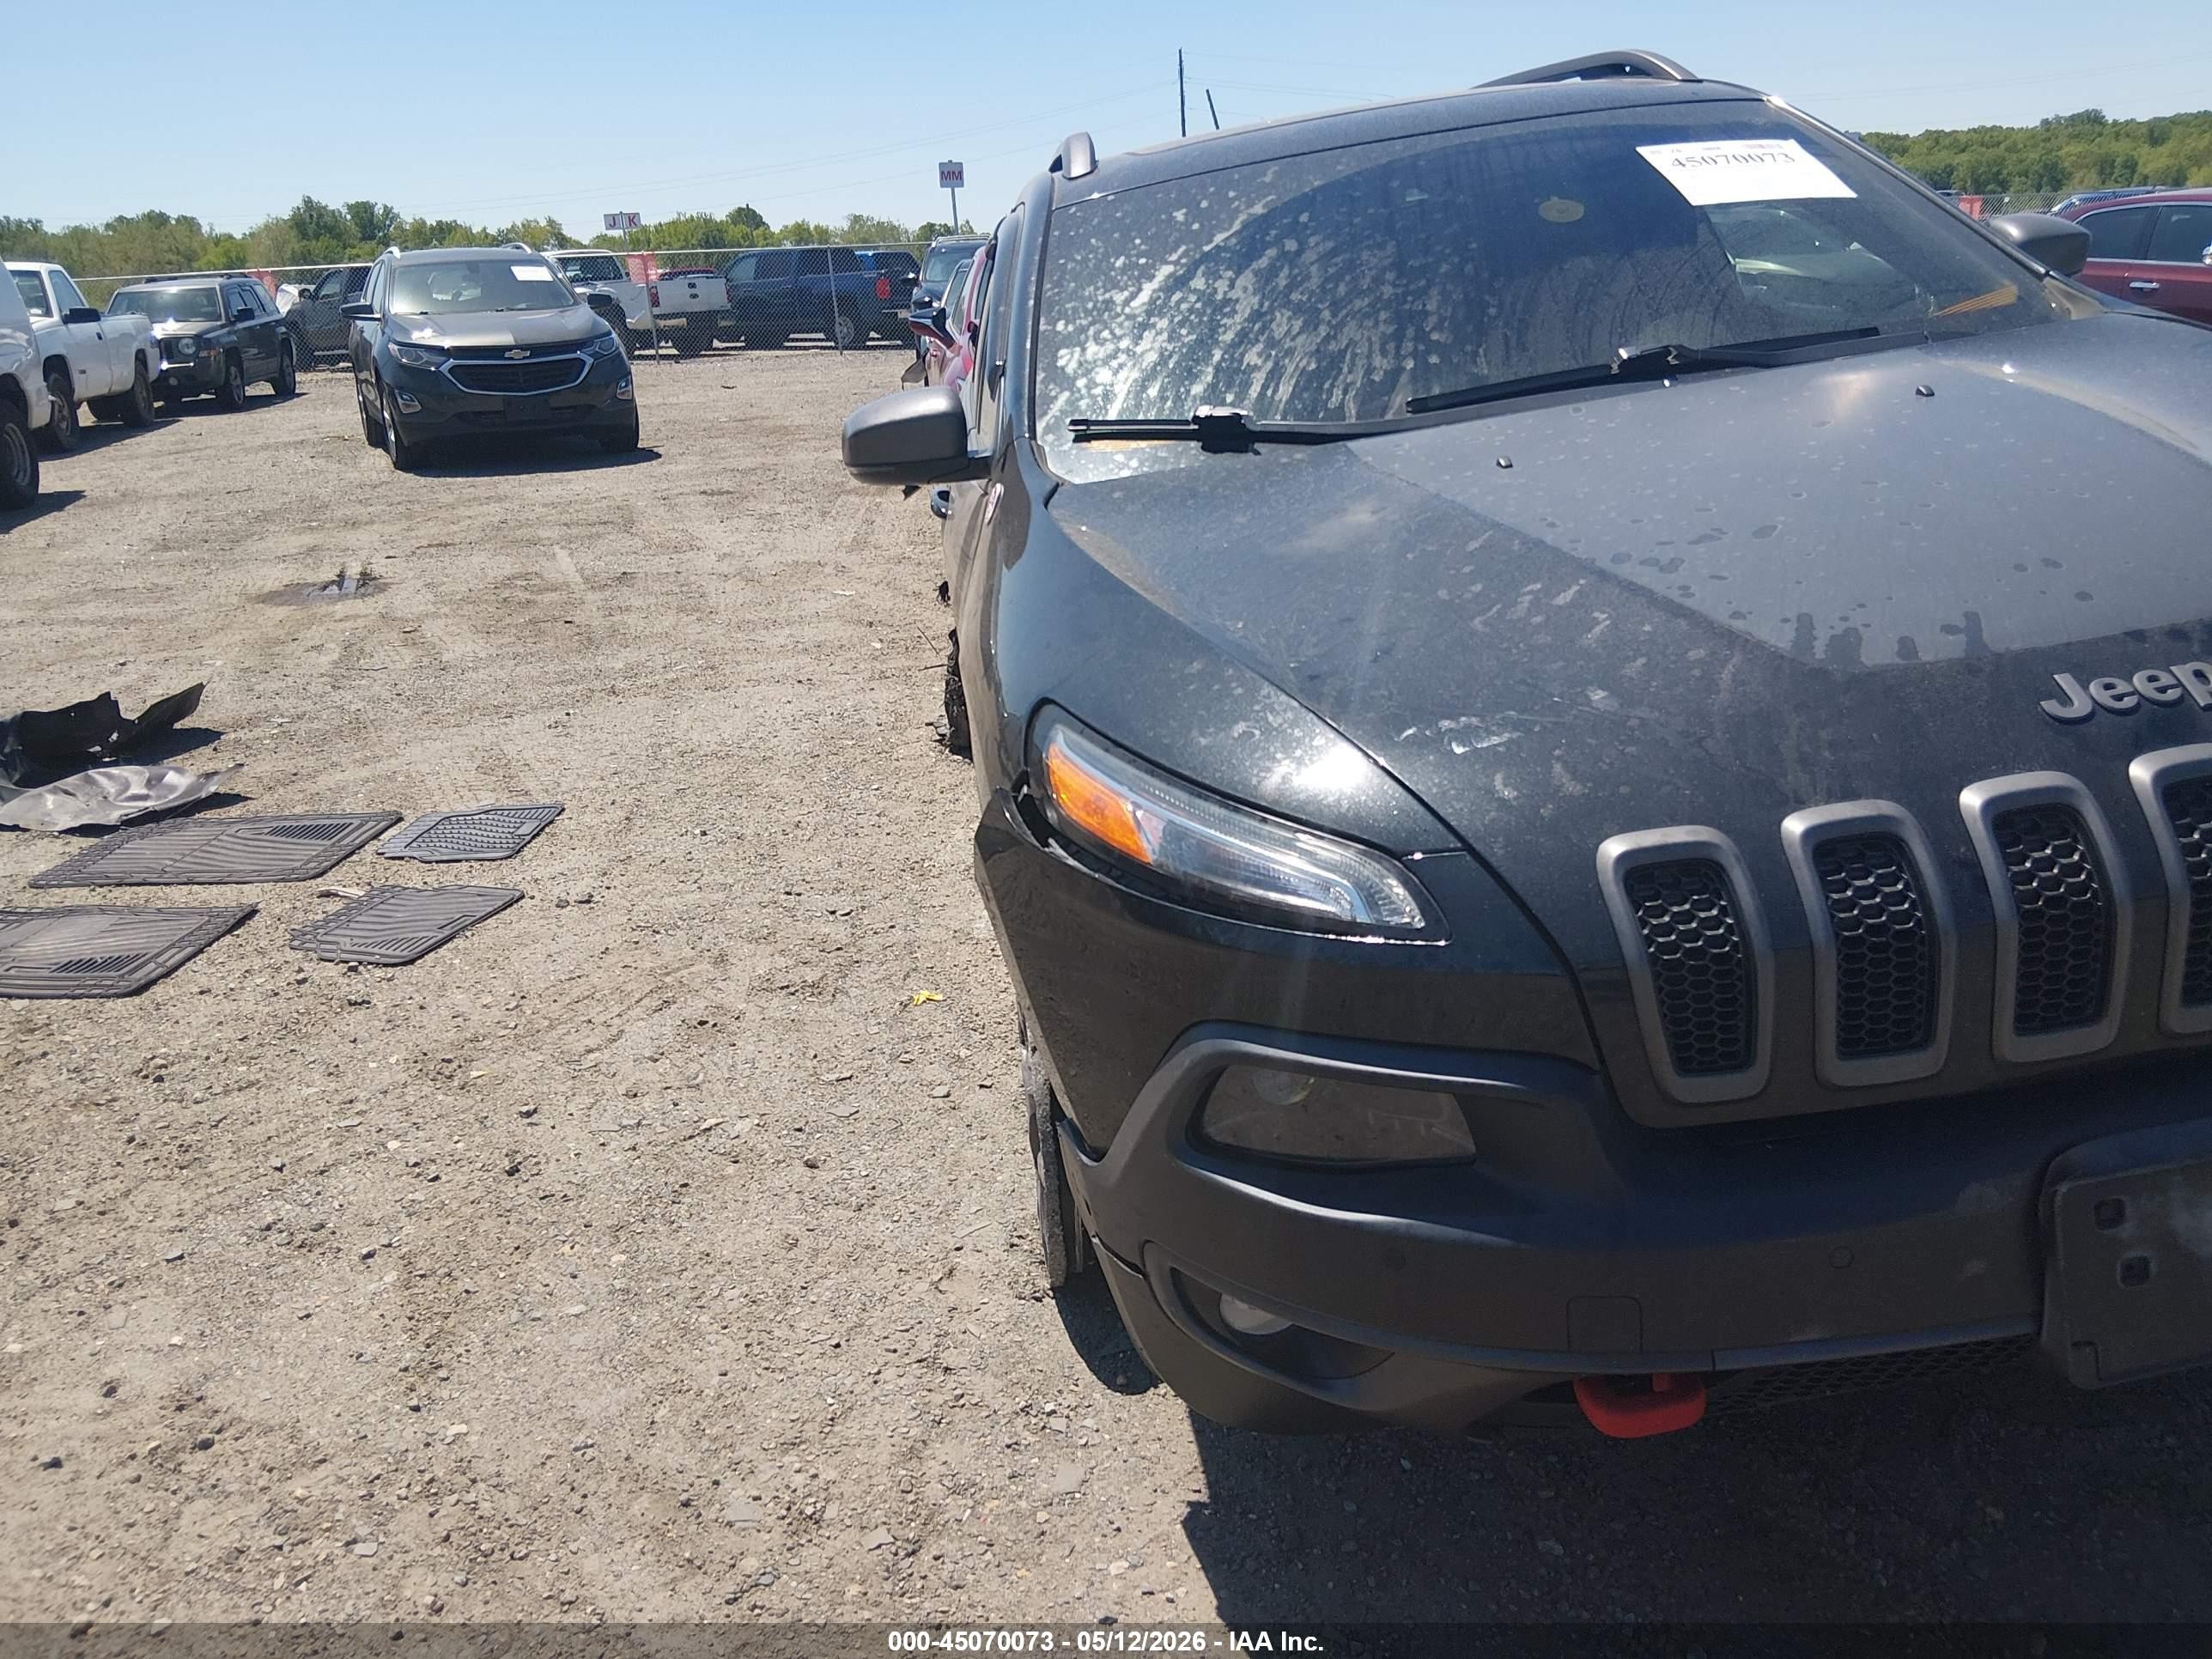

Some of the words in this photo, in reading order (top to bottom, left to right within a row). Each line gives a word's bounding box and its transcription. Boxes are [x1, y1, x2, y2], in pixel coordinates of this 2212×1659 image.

[1671, 152, 1796, 168] 45070073
[940, 170, 963, 181] MM
[609, 216, 617, 228] J
[628, 215, 638, 228] K
[2039, 661, 2212, 722] Jeep
